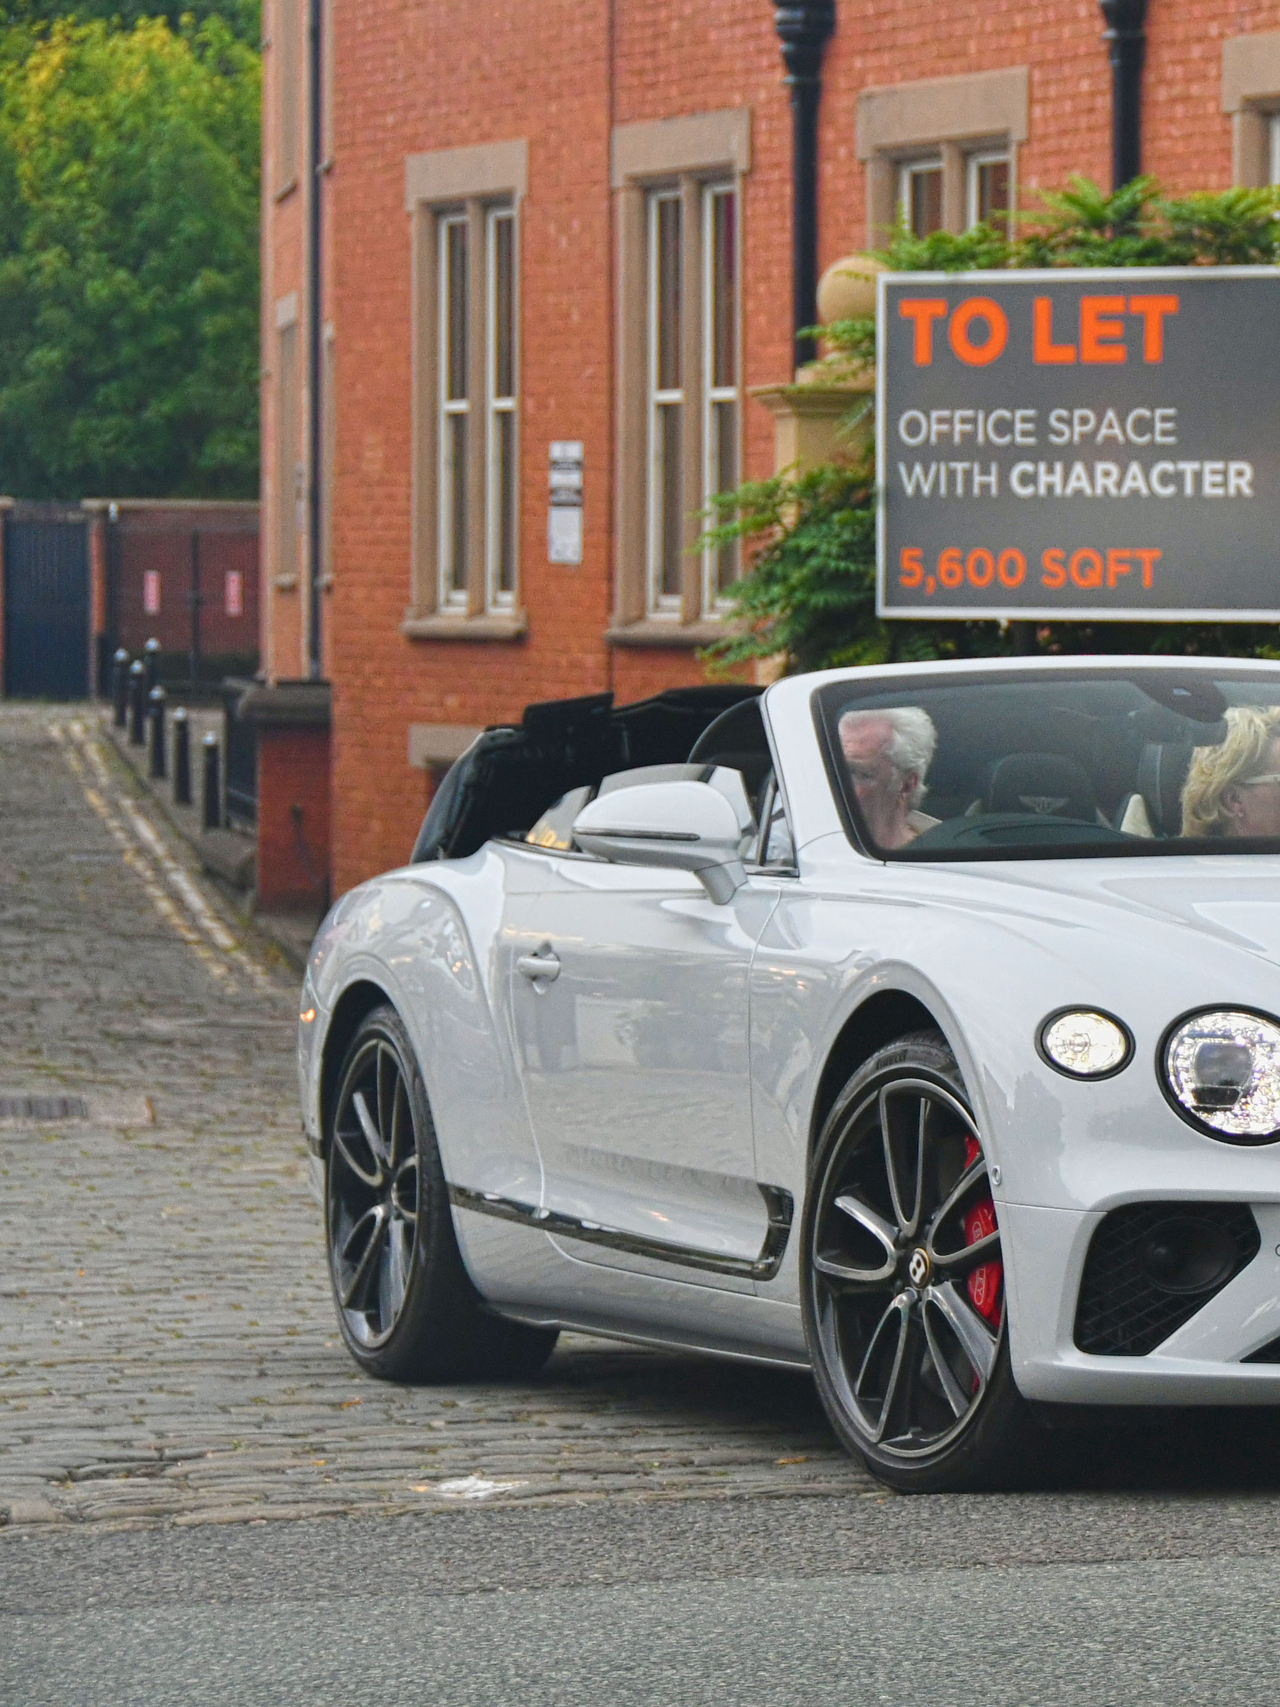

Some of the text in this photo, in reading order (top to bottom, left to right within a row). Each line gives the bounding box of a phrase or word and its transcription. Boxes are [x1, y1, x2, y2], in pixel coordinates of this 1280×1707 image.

[899, 294, 1180, 367] TO LET
[898, 407, 1178, 446] OFFICE SPACE
[898, 460, 1254, 498] WITH CHARACTER
[898, 547, 1162, 596] 5,600 SQFT
